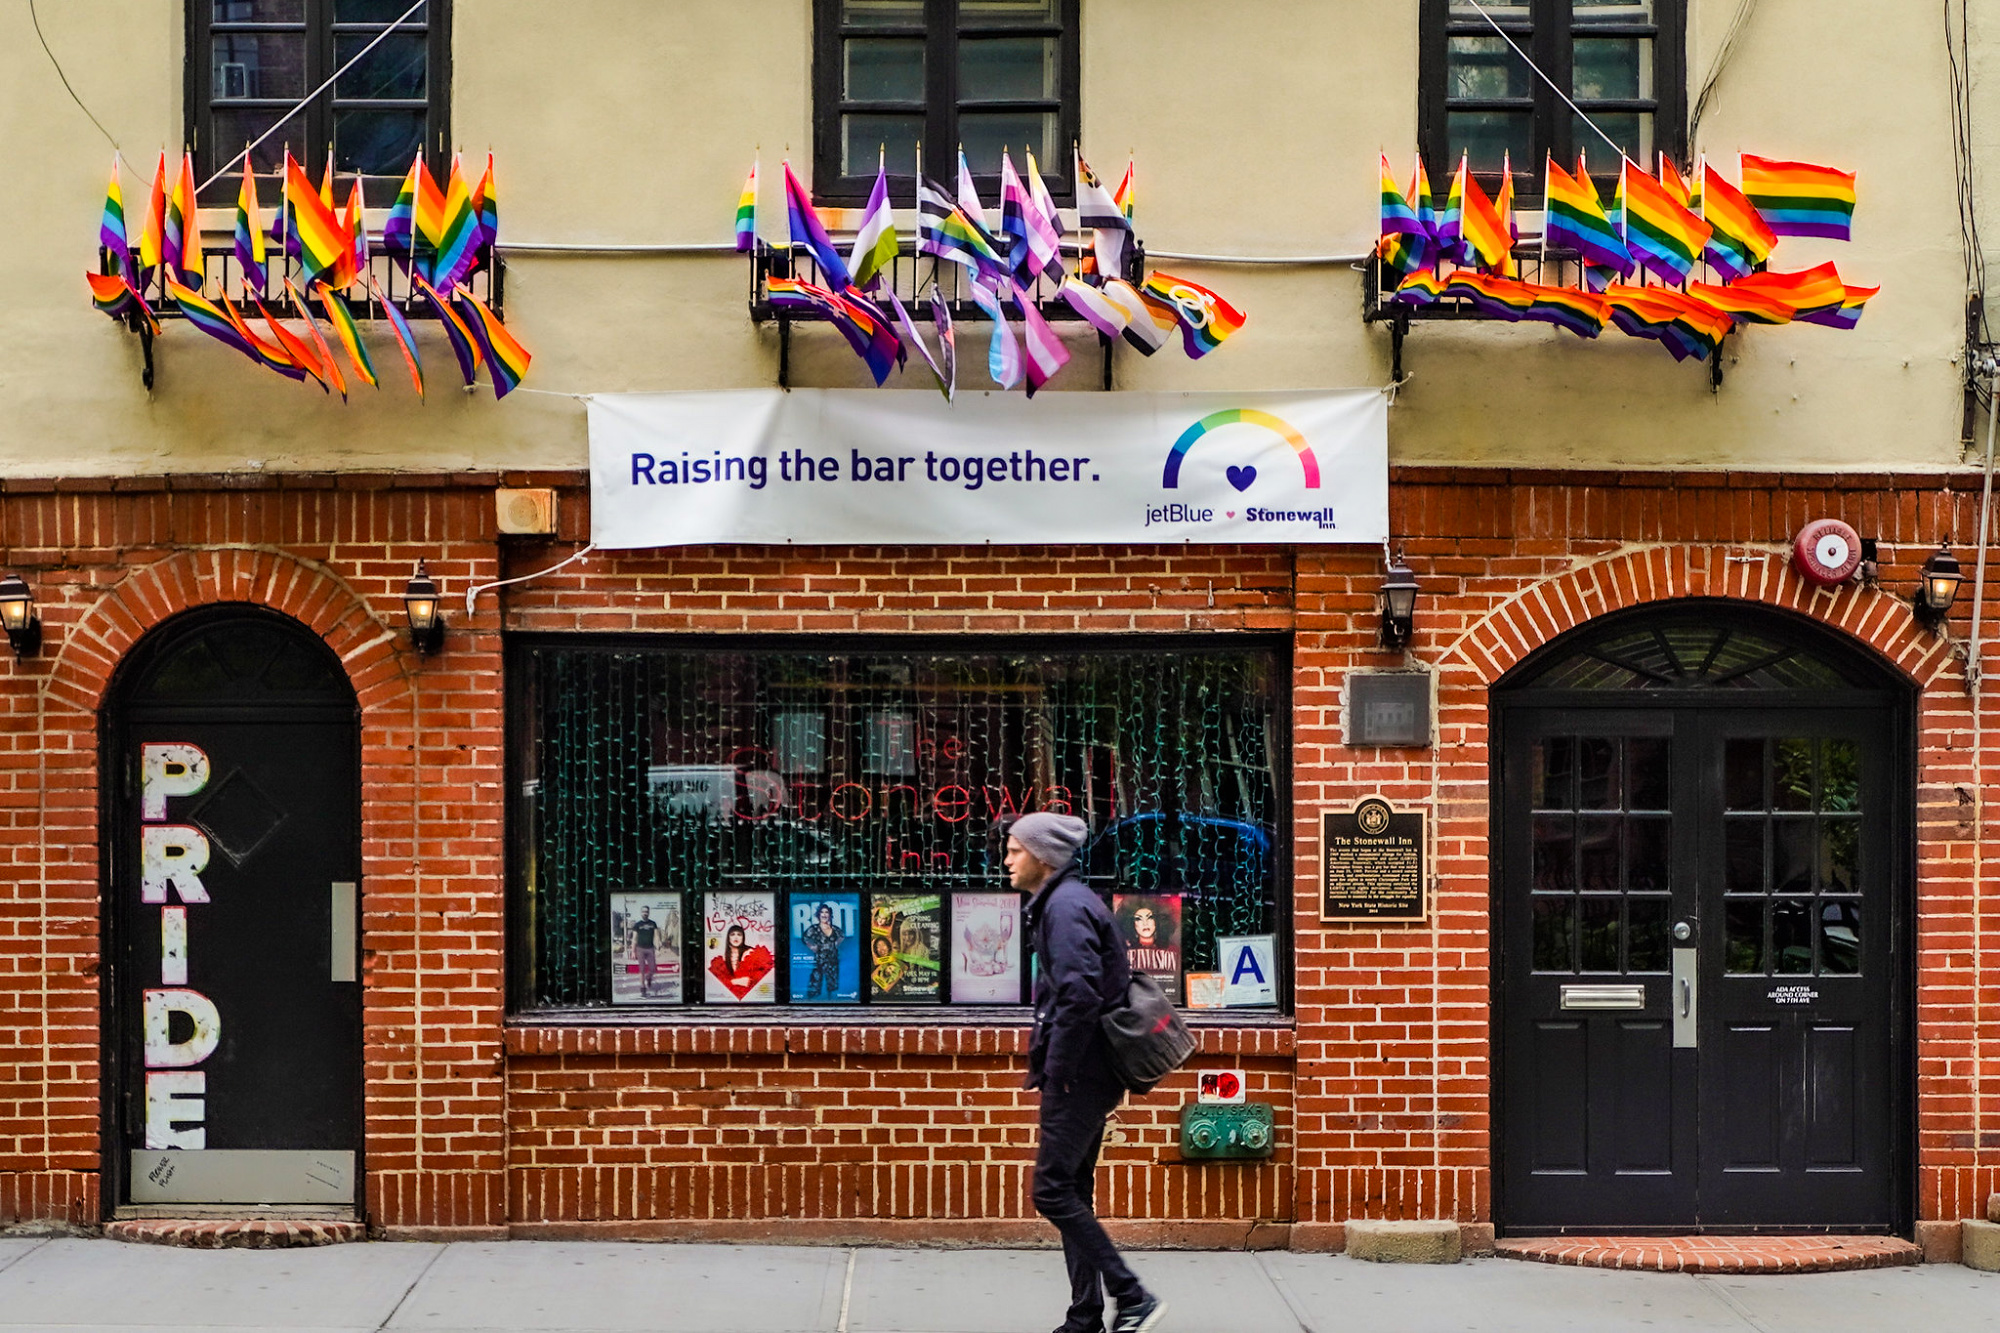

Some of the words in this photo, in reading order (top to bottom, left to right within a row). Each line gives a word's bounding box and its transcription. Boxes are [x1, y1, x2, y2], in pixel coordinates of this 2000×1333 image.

[631, 450, 768, 490] Raising
[778, 448, 840, 482] the
[851, 448, 916, 482] bar
[924, 449, 1100, 491] together.
[1144, 503, 1214, 528] jetBlue
[1246, 507, 1334, 522] Stonewall
[1318, 519, 1336, 530] Inn
[1335, 836, 1351, 845] The
[1354, 836, 1395, 845] Stonewall
[1398, 836, 1412, 845] Inn
[140, 741, 222, 1150] PRIDE
[1231, 945, 1266, 985] A
[1192, 1104, 1224, 1117] AUTO
